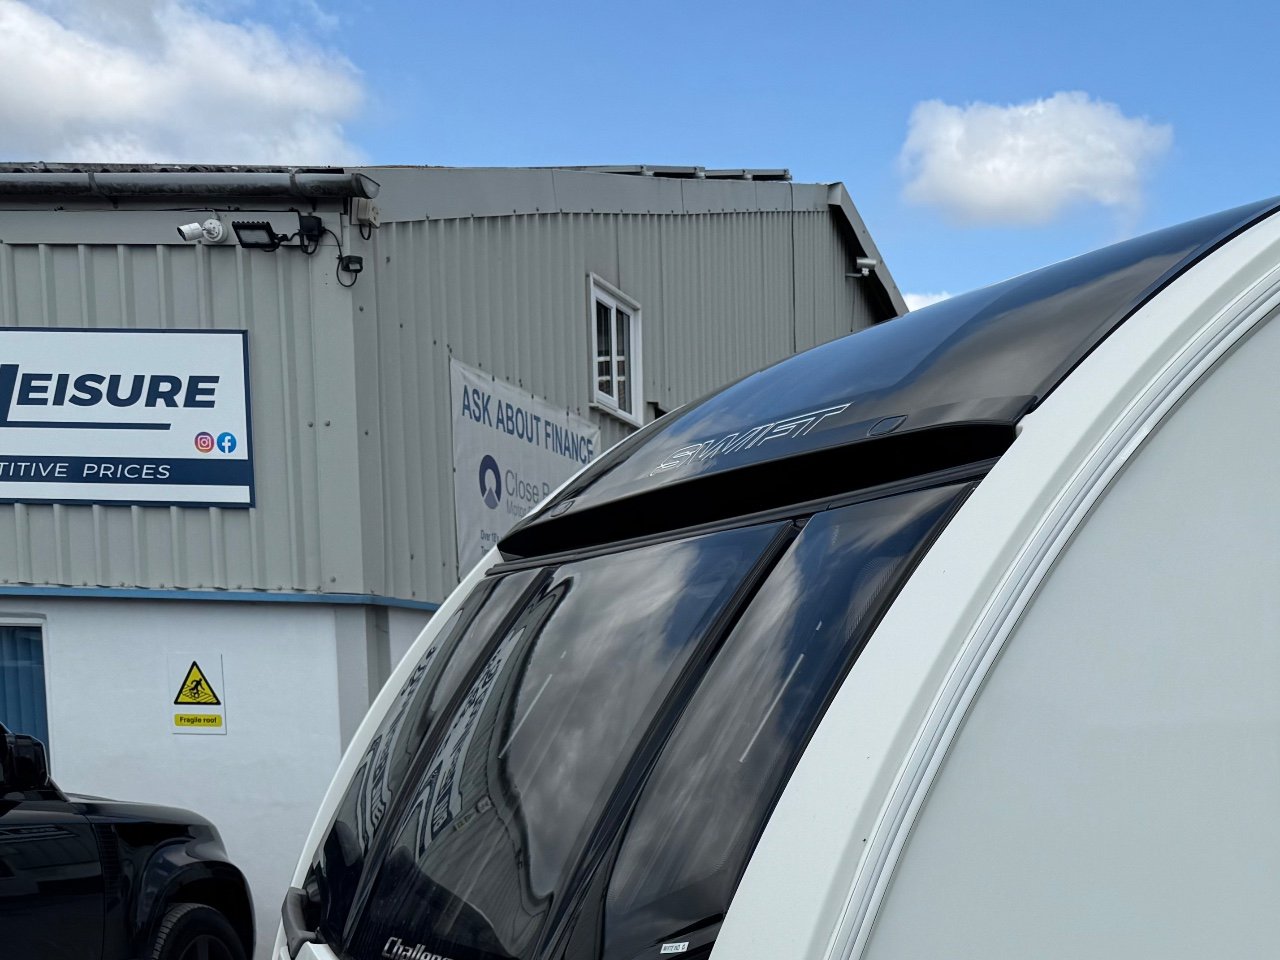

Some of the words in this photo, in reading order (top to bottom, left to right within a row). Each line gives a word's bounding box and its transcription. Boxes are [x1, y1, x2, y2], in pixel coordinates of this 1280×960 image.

[462, 385, 493, 428] ASK
[496, 400, 541, 447] ABOUT
[544, 420, 594, 465] FINANCE
[650, 400, 853, 476] SWIFT
[83, 463, 170, 479] PRICES
[505, 469, 540, 505] Close
